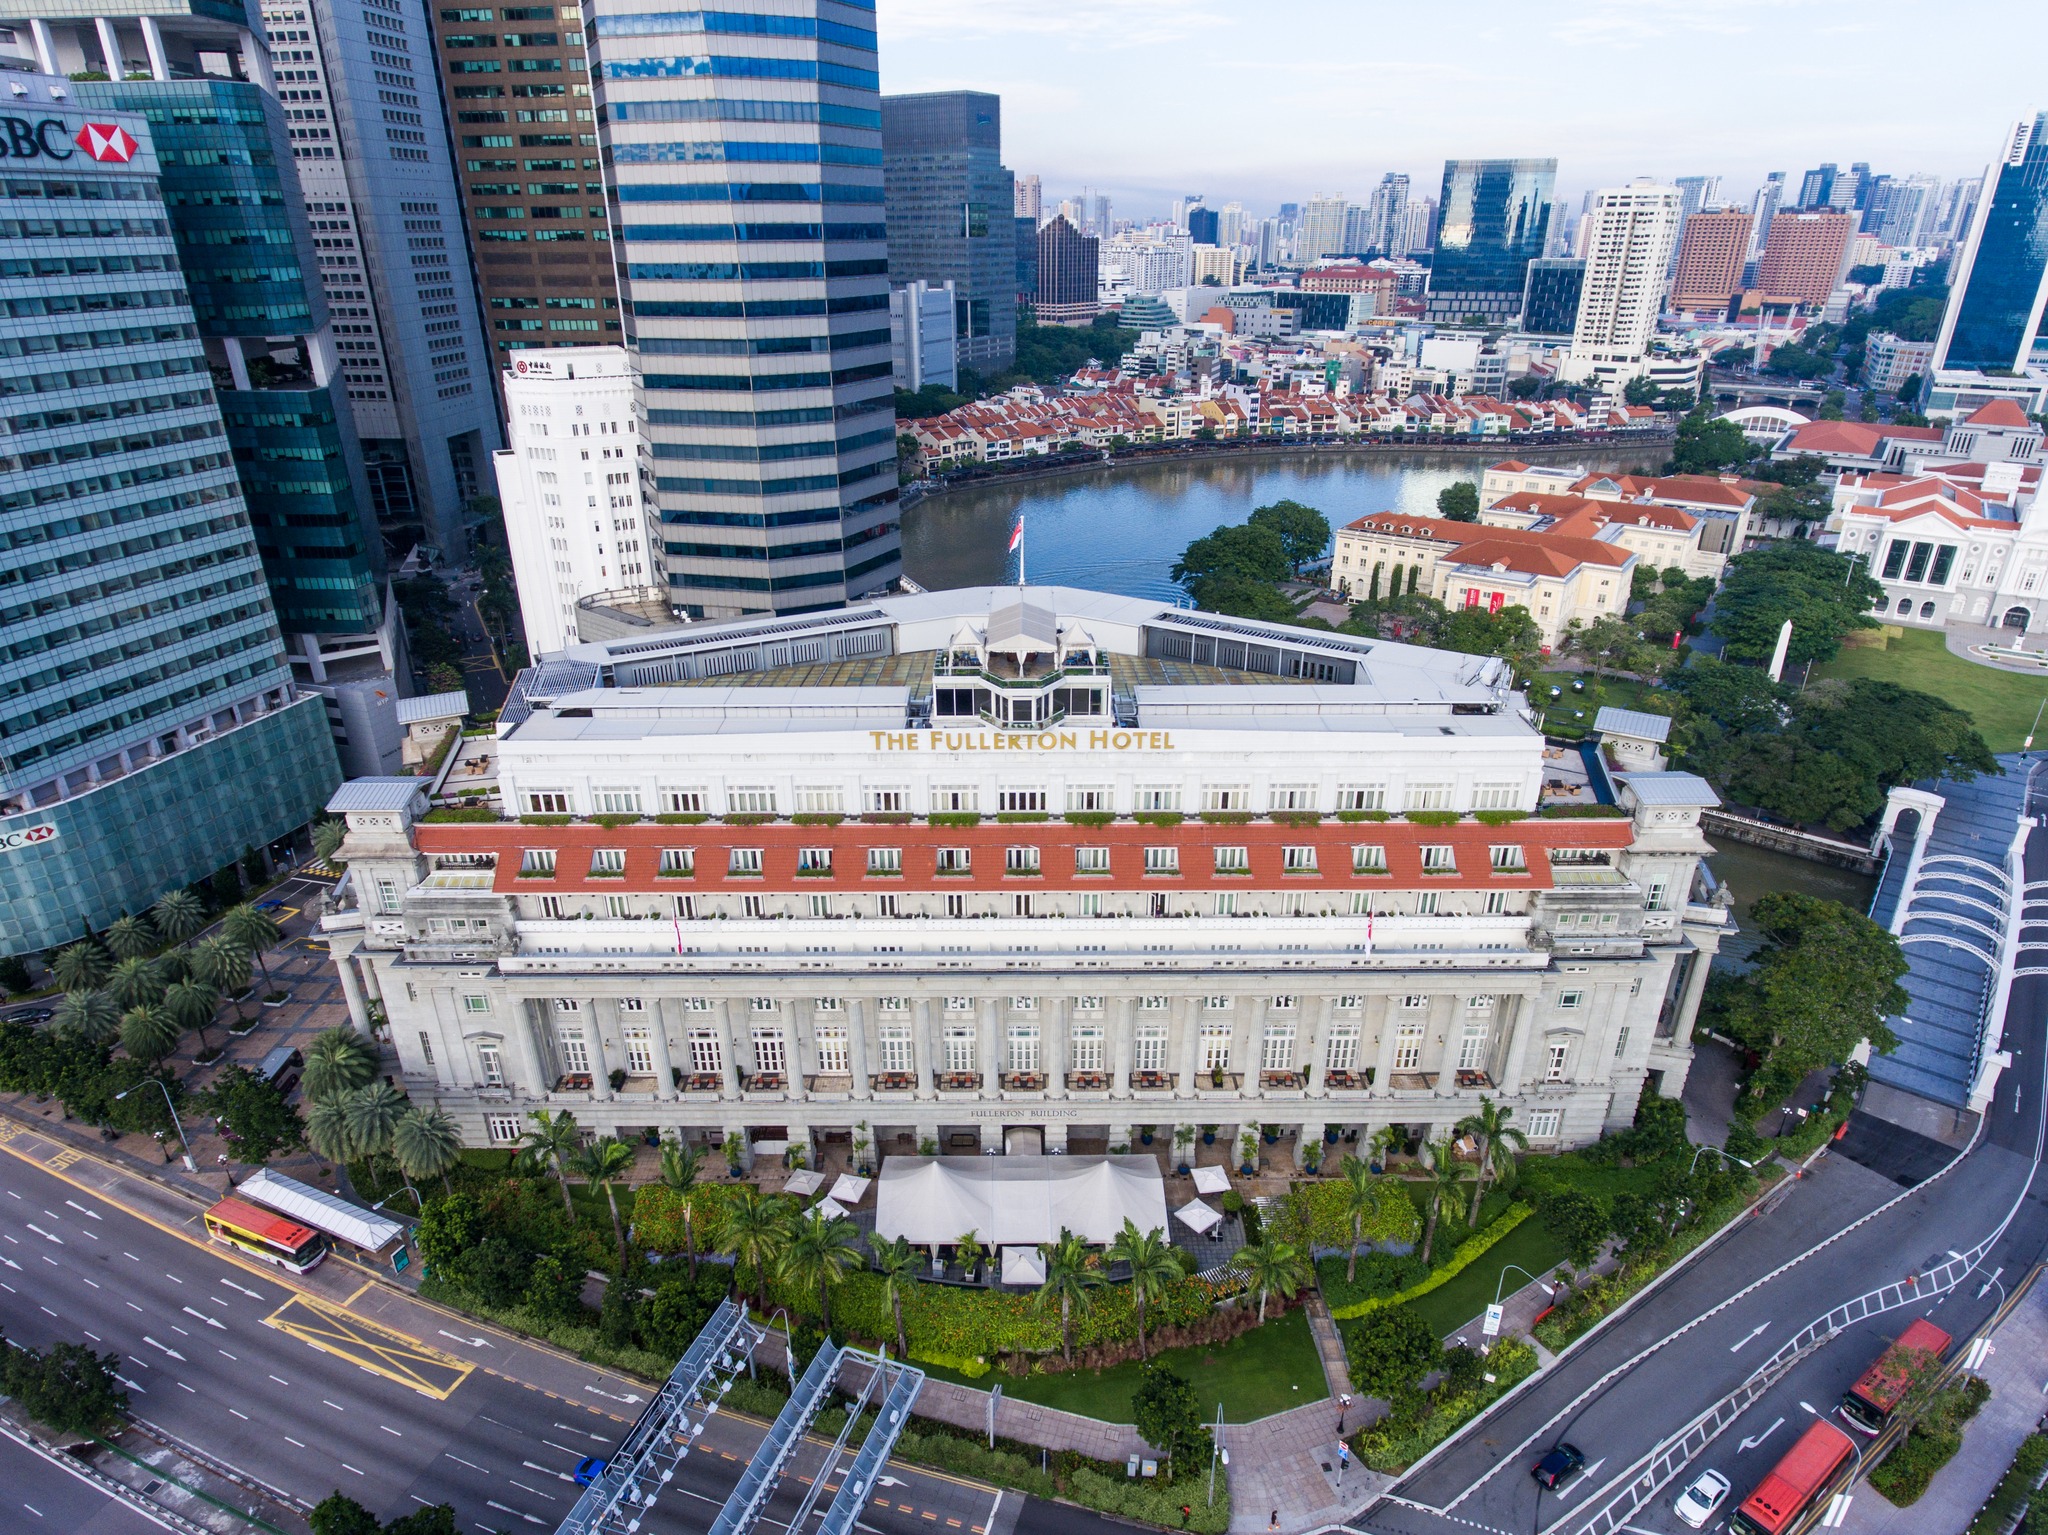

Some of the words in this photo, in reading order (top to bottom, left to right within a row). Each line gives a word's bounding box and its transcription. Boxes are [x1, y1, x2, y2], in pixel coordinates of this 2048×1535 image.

[869, 731, 918, 750] THE
[930, 731, 1076, 750] FULLERTON
[1090, 730, 1174, 749] HOTEL
